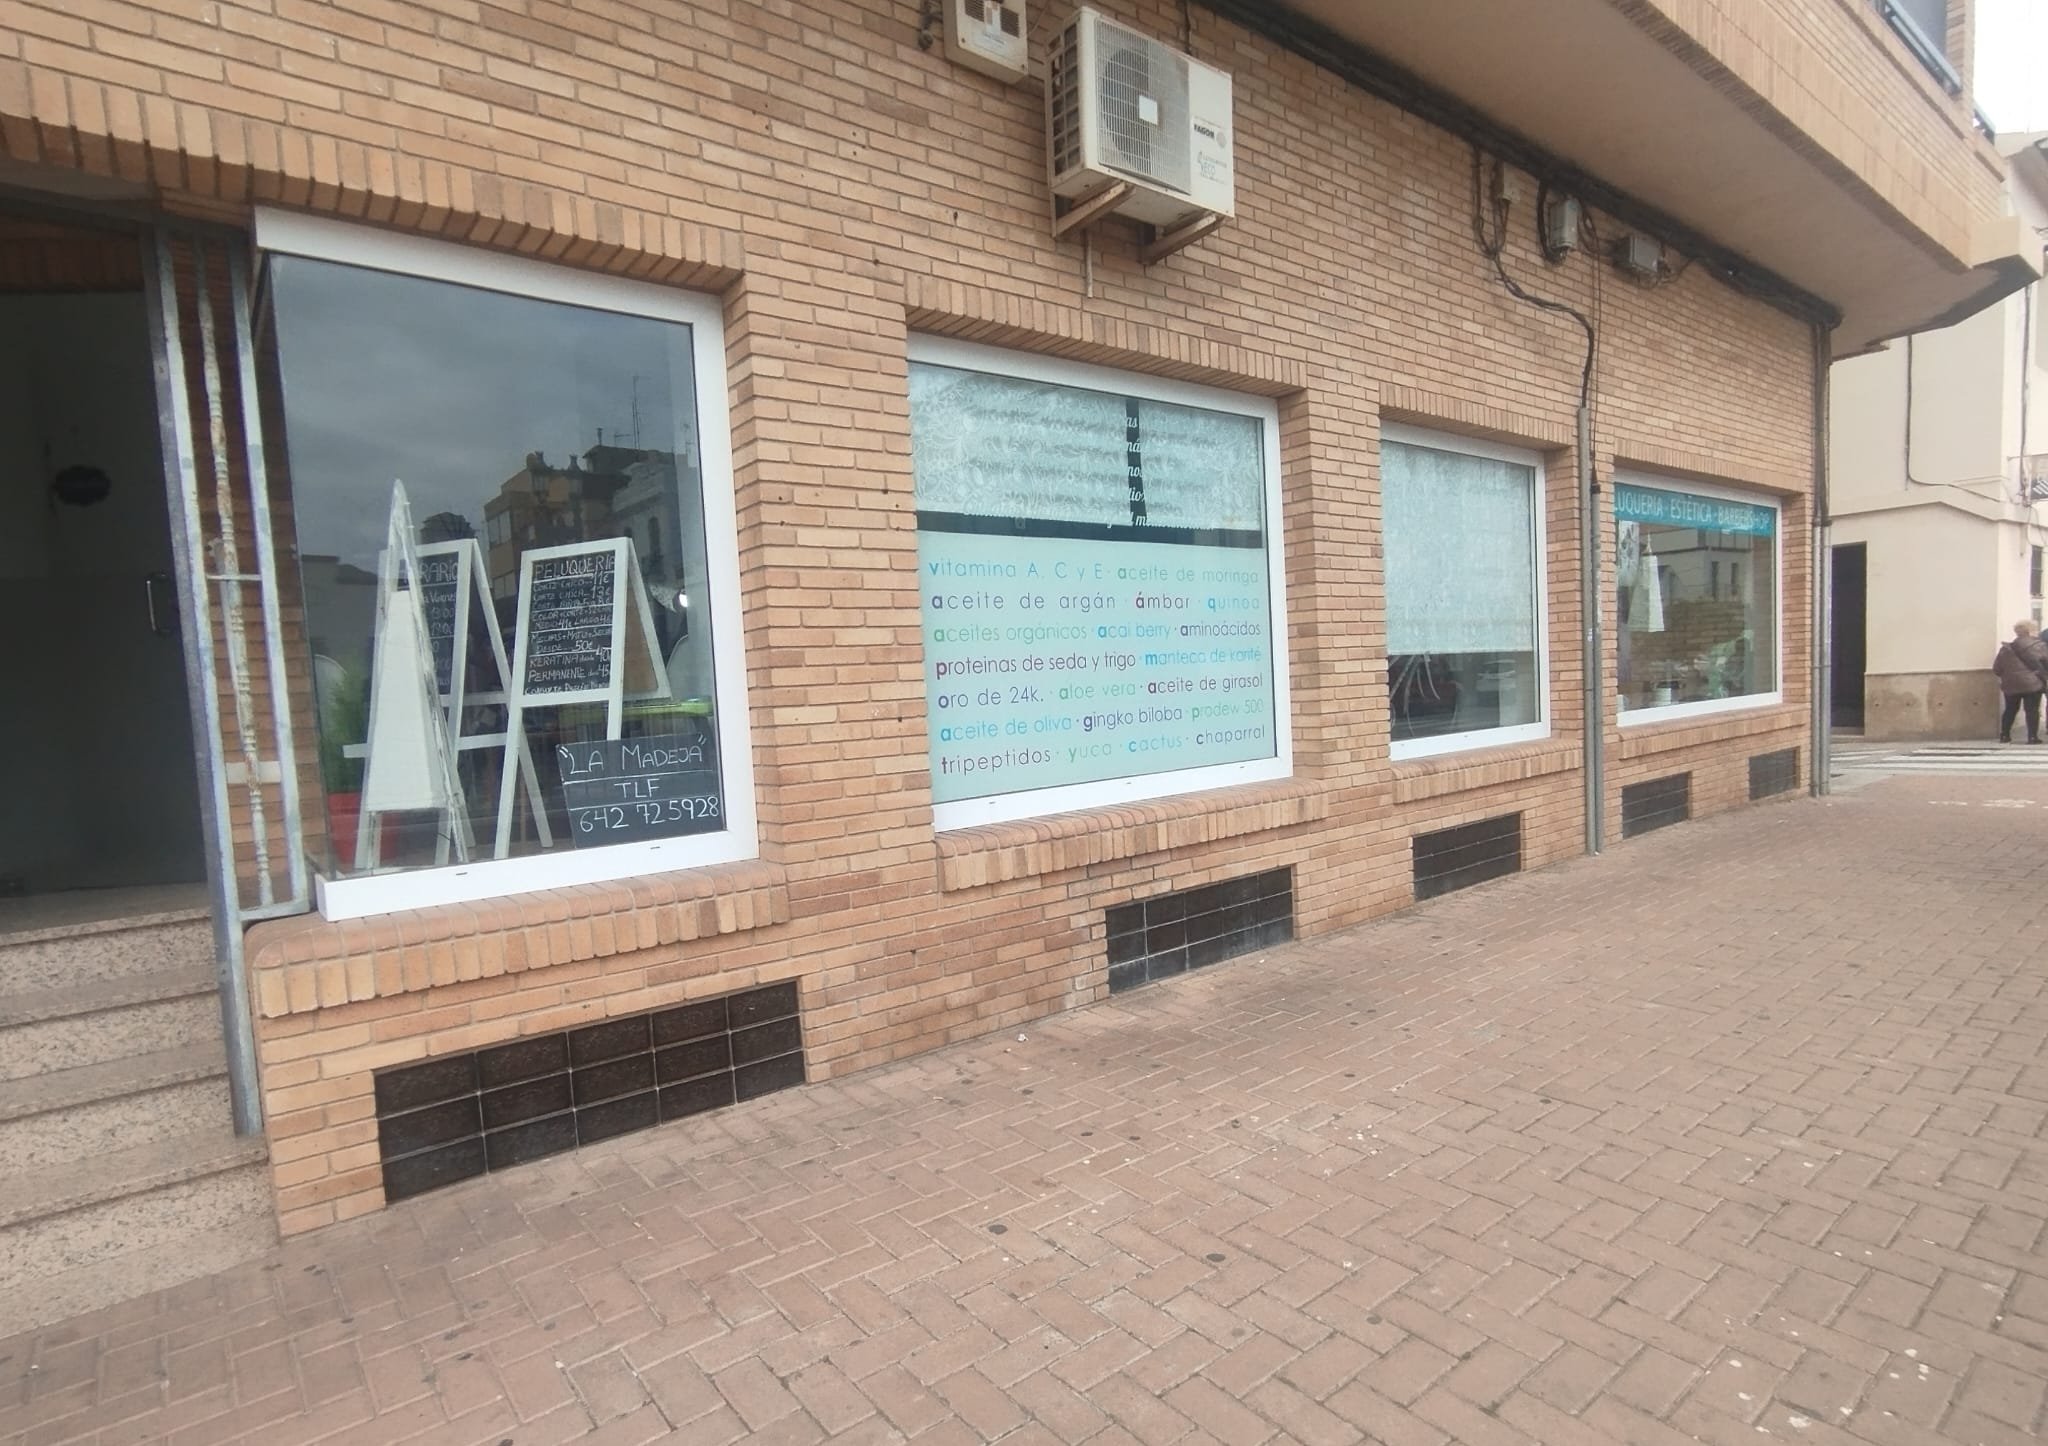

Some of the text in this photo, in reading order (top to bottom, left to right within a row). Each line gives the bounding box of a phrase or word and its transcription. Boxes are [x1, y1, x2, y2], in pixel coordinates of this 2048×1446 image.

[929, 559, 1016, 578] vitamina
[1054, 562, 1068, 578] C
[1076, 567, 1085, 581] y
[1095, 563, 1103, 579] E
[1117, 565, 1168, 581] aceite
[1176, 567, 1195, 581] de
[1203, 568, 1259, 586] moringa
[932, 592, 1259, 612] aceite de argán ámbar quinoa
[934, 624, 1000, 642] aceites
[1006, 622, 1087, 645] orgánicos
[1136, 624, 1171, 640] berry
[1180, 620, 1261, 636] aminoácidos
[1022, 654, 1044, 671] de
[1049, 652, 1087, 670] seda
[1091, 656, 1099, 671] y
[1104, 651, 1136, 671] trigo
[1145, 651, 1206, 666] manteca
[1210, 648, 1227, 663] de
[938, 693, 968, 709] oro
[977, 688, 1001, 706] de
[1059, 684, 1095, 700] aloe
[1102, 683, 1136, 697] vera
[1148, 677, 1193, 694] aceite
[1199, 676, 1216, 691] de
[1223, 672, 1263, 693] girasol
[941, 699, 1263, 742] aceite de oliva gingko biloba prodew 500
[941, 725, 1265, 776] tripeptidos yuca cactus chaparral
[614, 779, 660, 798] TLF
[580, 807, 629, 832] 642
